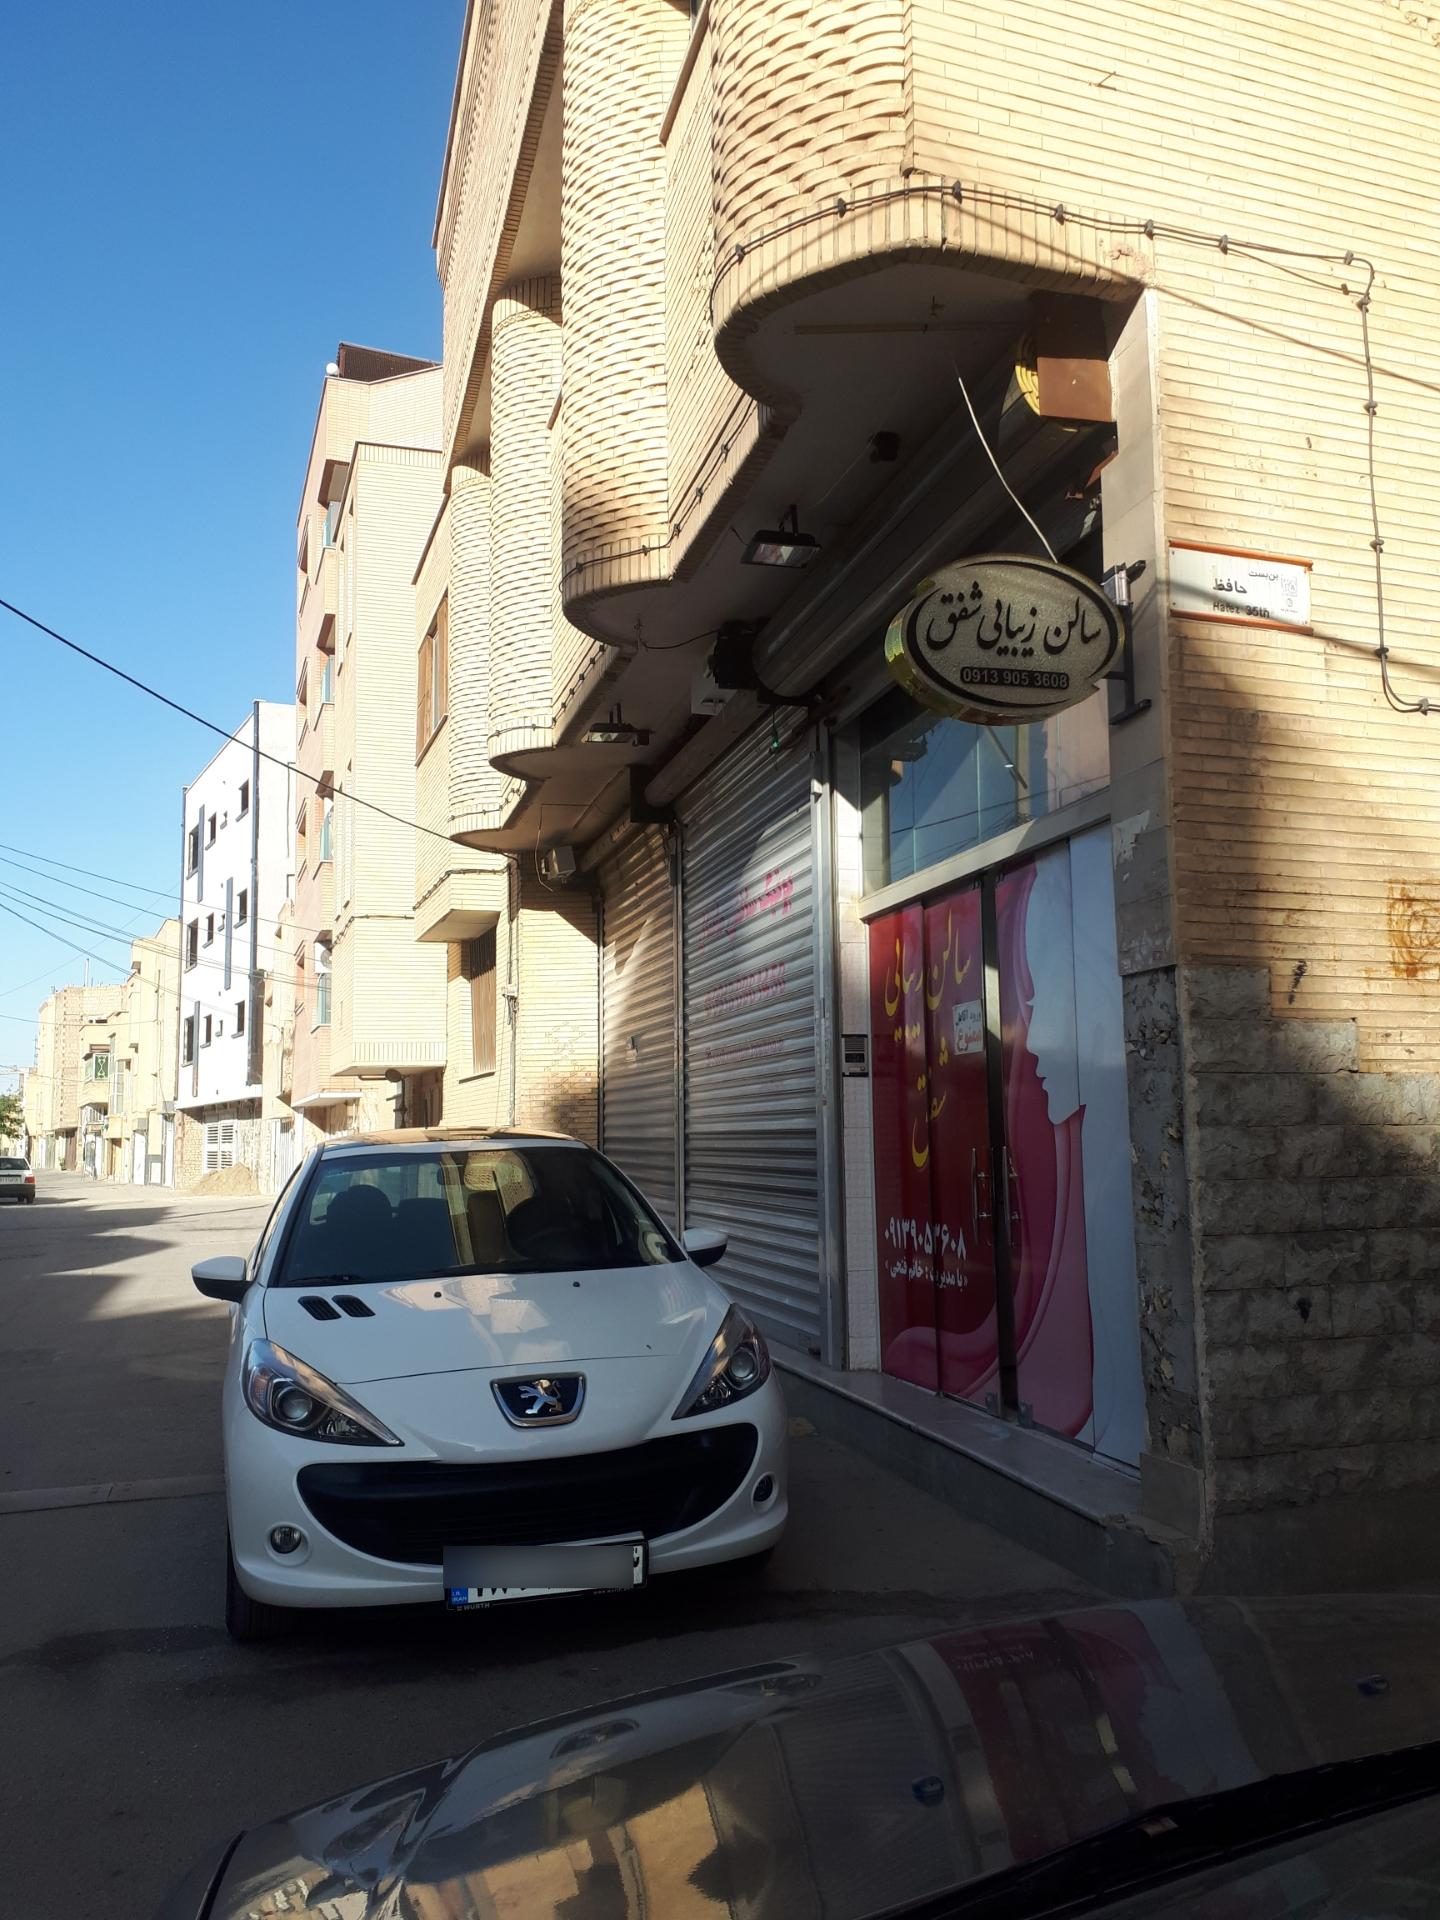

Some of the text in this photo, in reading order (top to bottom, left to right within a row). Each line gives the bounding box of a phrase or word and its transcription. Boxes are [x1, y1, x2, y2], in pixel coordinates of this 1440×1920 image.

[1212, 577, 1248, 595] حافظ
[1212, 601, 1241, 615] Hafez
[926, 580, 1102, 659] سالن زیبایی شفق
[962, 668, 1069, 690] 0913 905 3608
[926, 908, 972, 1011] سالن
